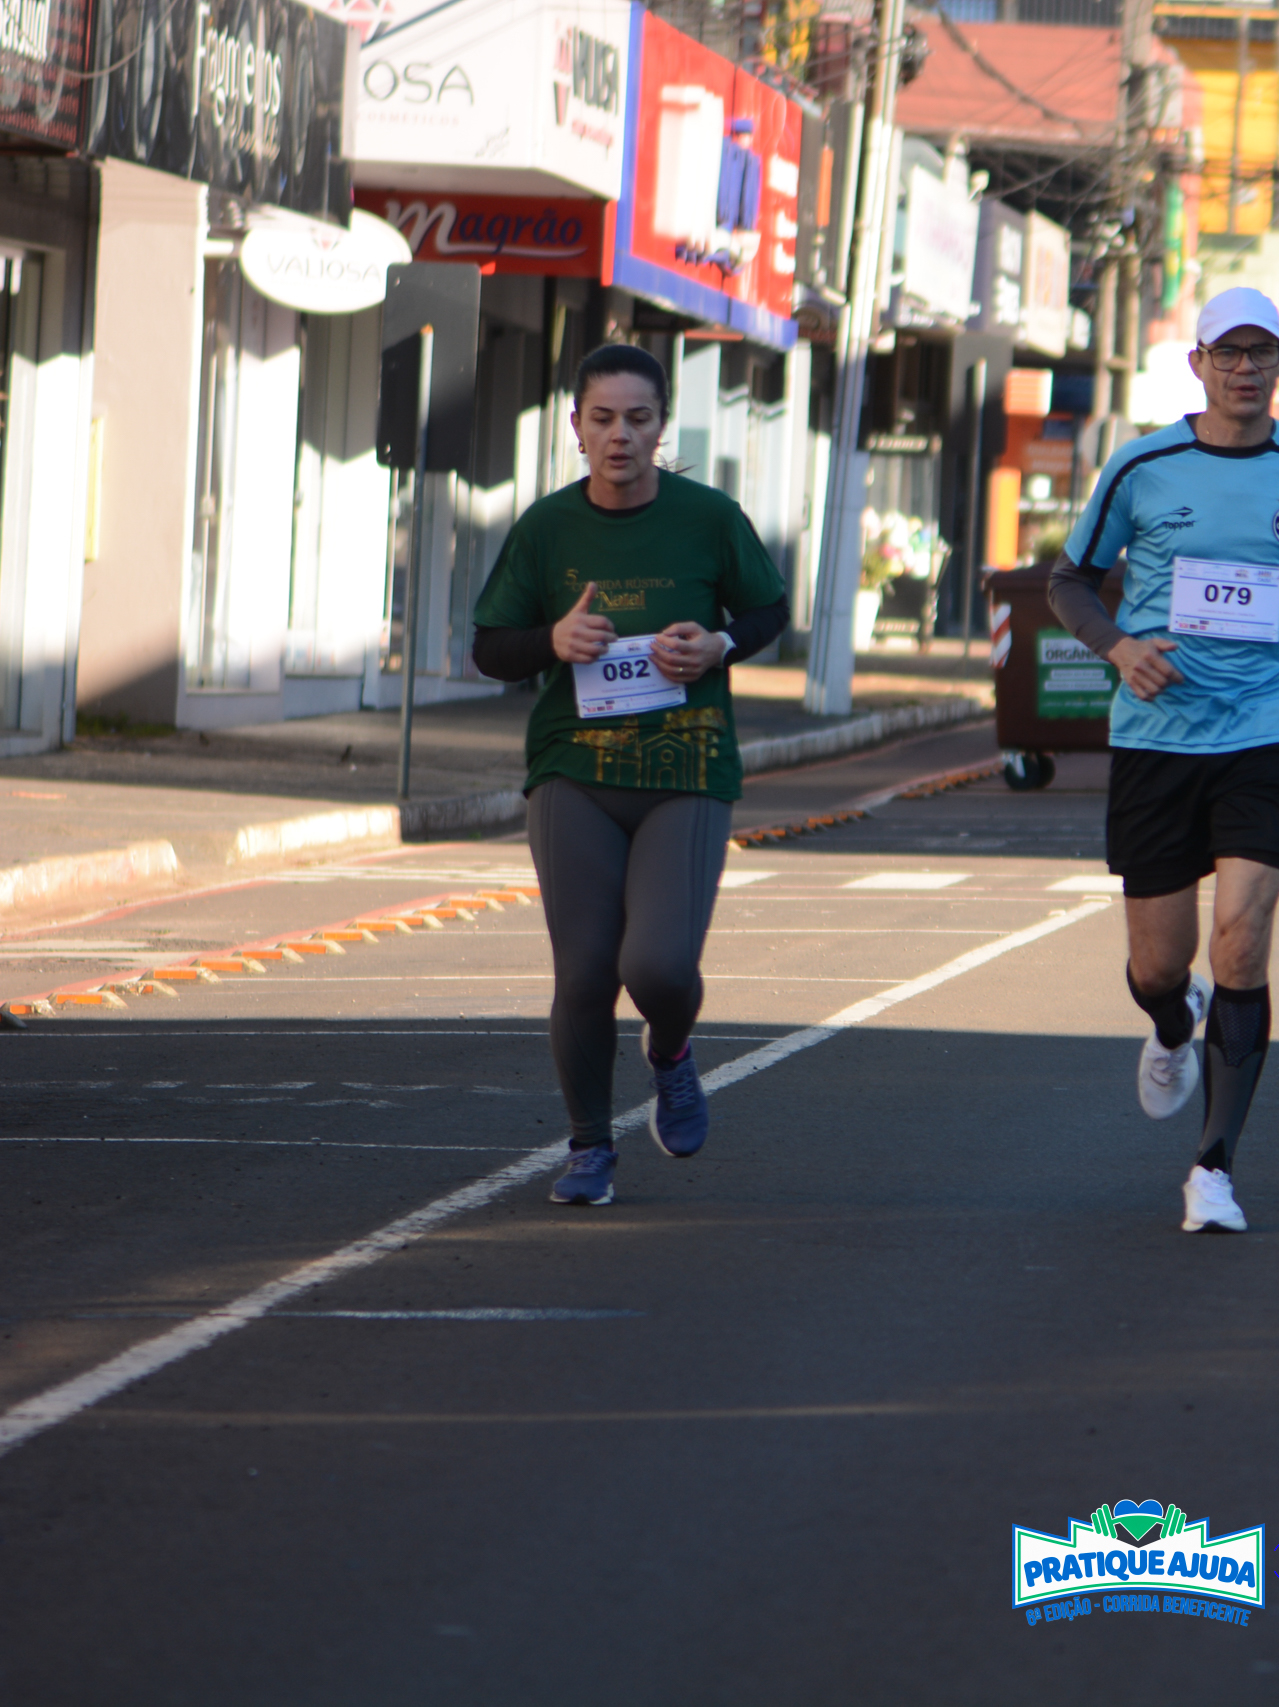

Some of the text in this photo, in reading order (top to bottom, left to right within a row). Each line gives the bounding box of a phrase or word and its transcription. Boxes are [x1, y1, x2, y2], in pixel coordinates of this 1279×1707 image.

[385, 200, 588, 258] Magrão
[267, 253, 382, 284] VALIOSA
[1162, 519, 1197, 532] Topper
[572, 579, 622, 592] CORIDA
[1204, 584, 1252, 606] 079
[595, 590, 645, 608] Natal
[1045, 646, 1097, 661] ORGÂNI
[602, 659, 651, 682] 082
